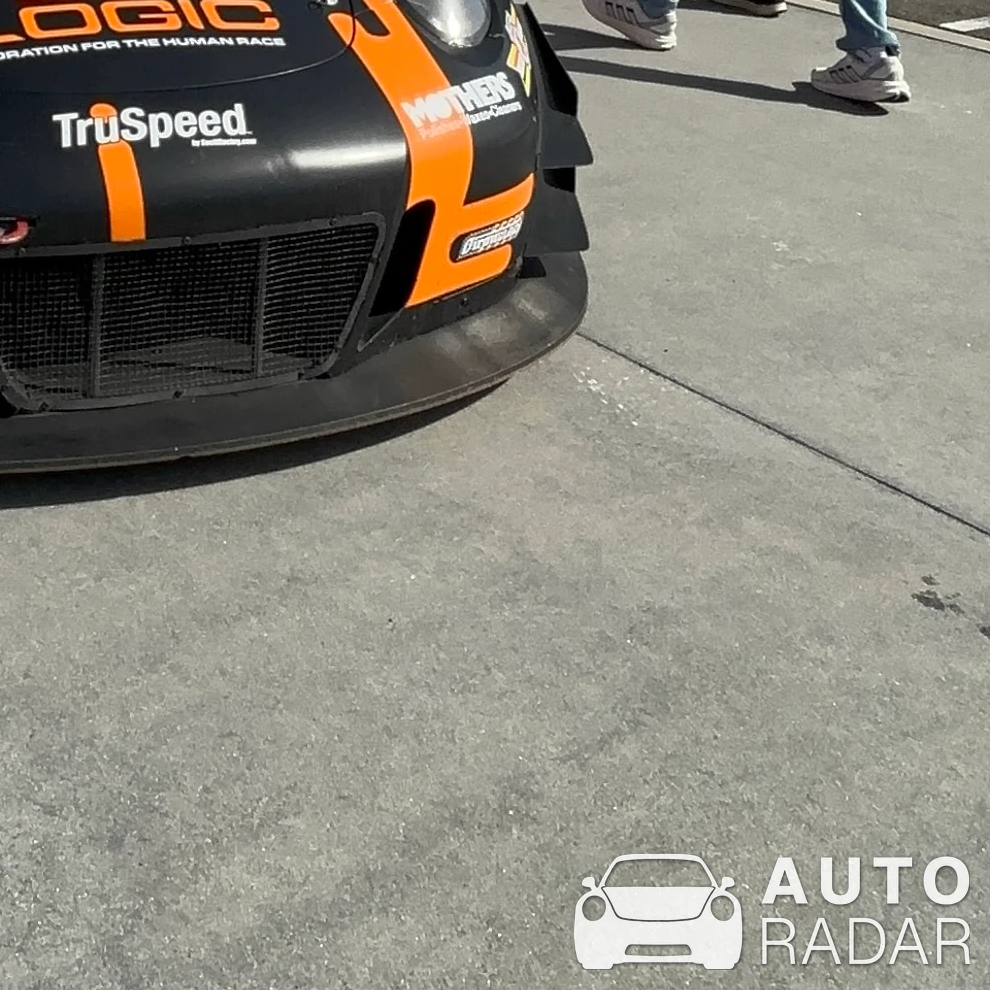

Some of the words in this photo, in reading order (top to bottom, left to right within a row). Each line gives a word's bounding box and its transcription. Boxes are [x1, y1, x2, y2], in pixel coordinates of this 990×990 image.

[81, 39, 121, 52] FOR
[122, 38, 161, 49] THE
[162, 36, 235, 47] HUMAN
[236, 37, 287, 47] RACE
[400, 71, 516, 129] MOTHERS
[52, 103, 250, 148] TruSpeed
